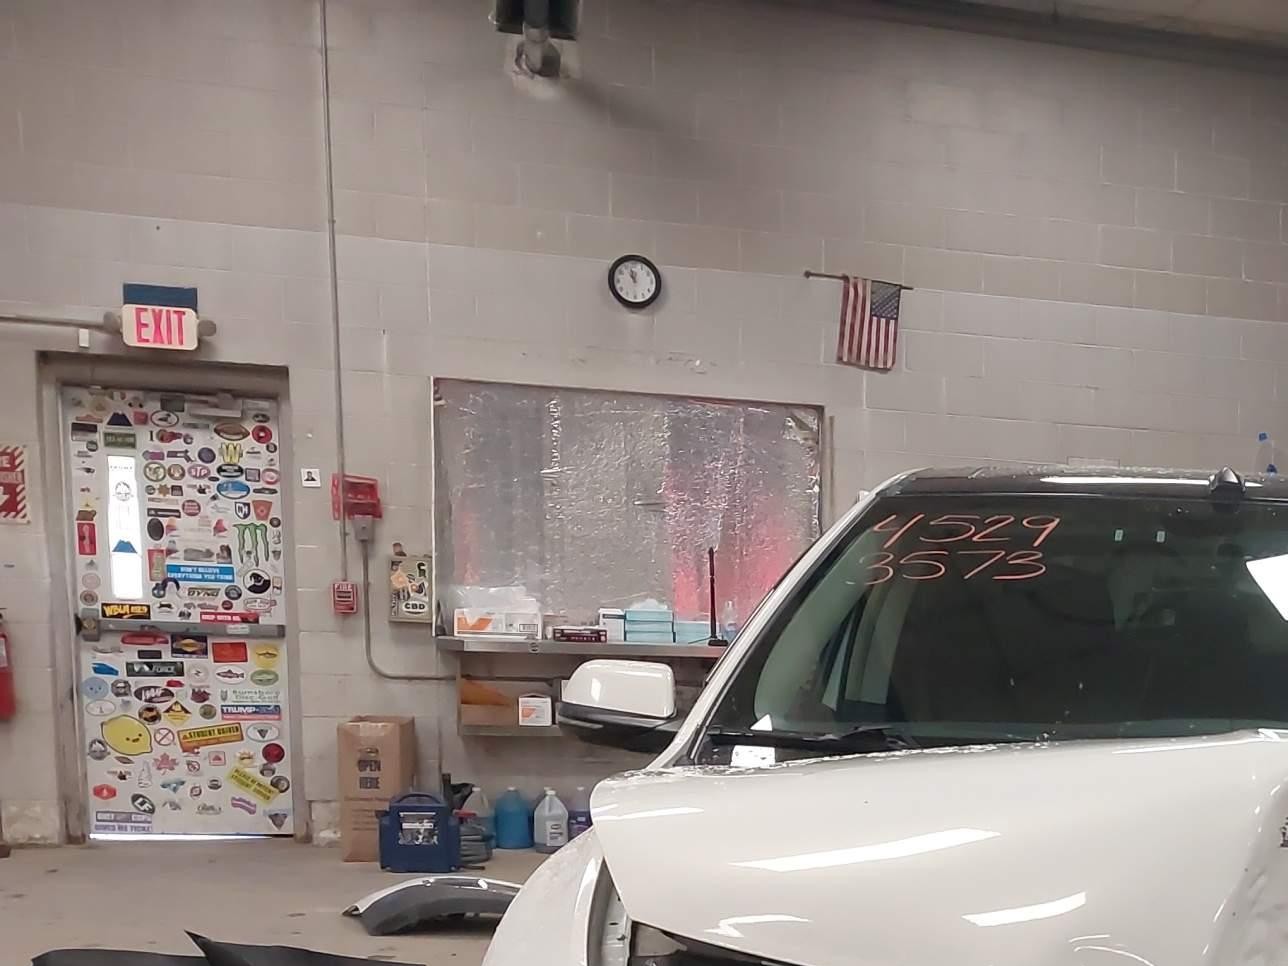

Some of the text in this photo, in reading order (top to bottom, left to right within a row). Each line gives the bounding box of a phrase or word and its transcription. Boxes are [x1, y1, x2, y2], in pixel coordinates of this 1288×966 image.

[134, 307, 185, 346] EXIT
[191, 465, 209, 478] STP
[873, 513, 1061, 548] 4529
[846, 550, 1047, 585] 3573
[404, 602, 426, 610] CBD
[222, 706, 256, 714] TRUMP
[187, 725, 239, 739] STUDENT DRIVER
[358, 759, 381, 772] OPEN
[359, 776, 380, 789] HERE
